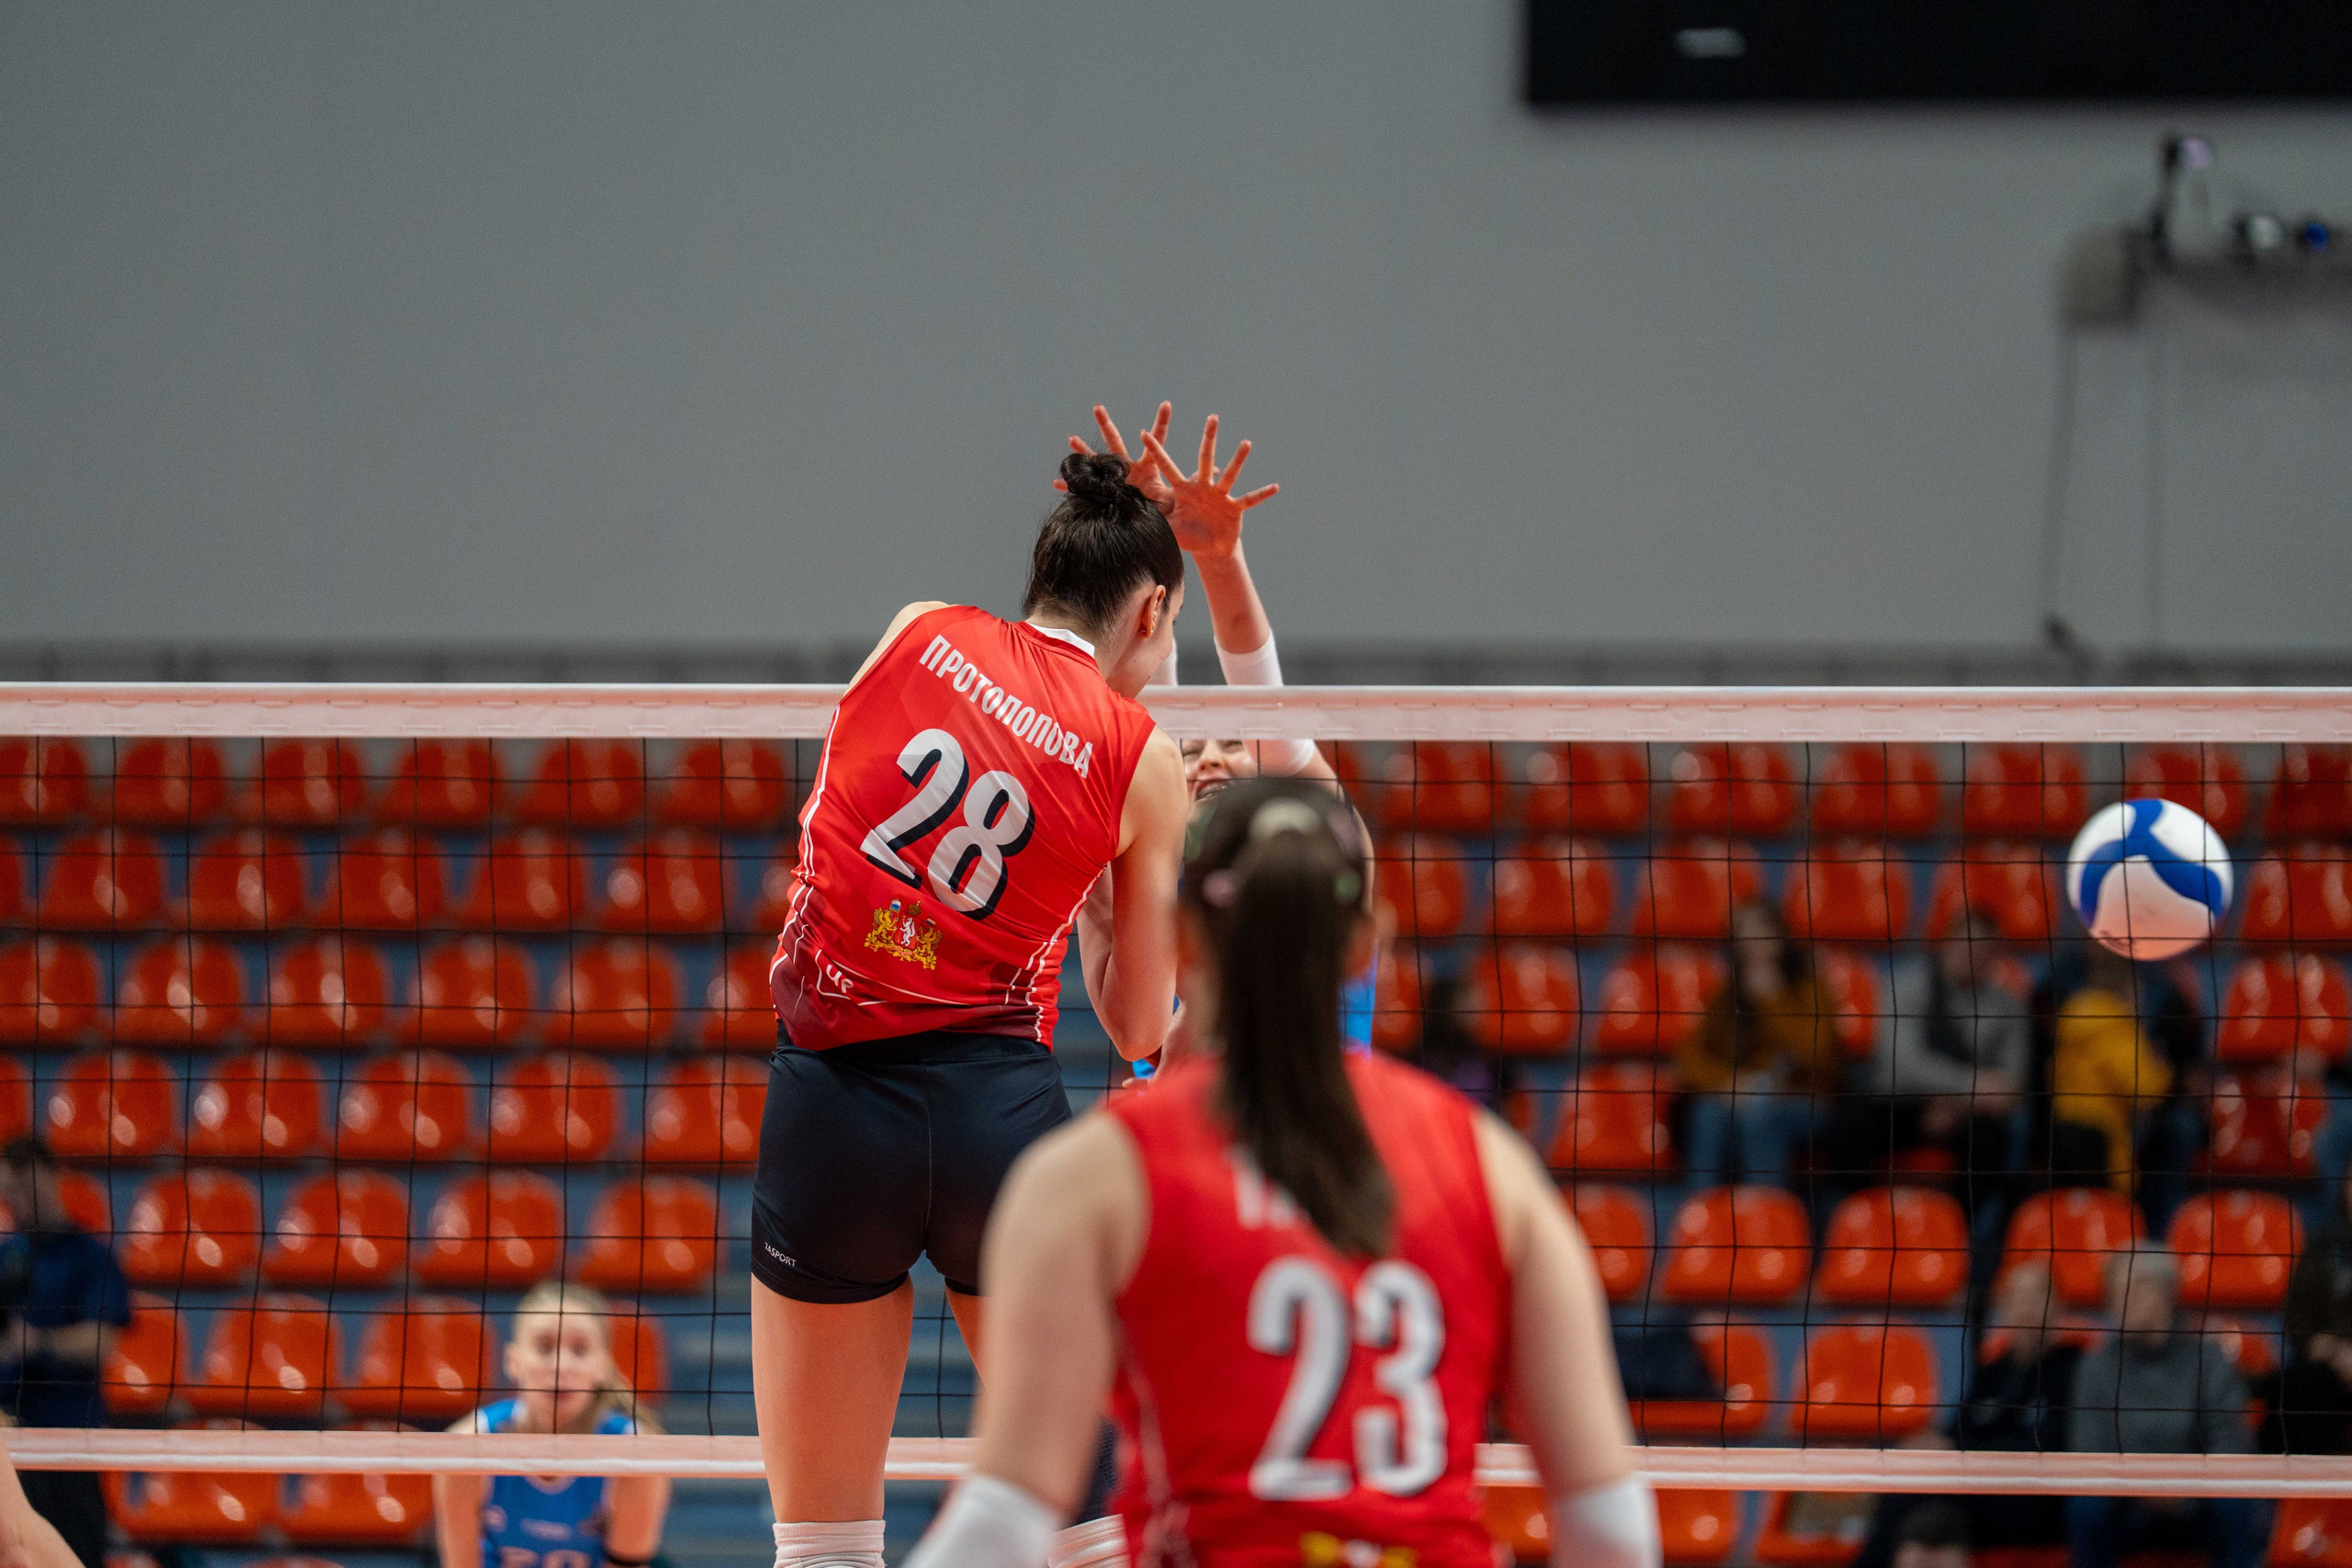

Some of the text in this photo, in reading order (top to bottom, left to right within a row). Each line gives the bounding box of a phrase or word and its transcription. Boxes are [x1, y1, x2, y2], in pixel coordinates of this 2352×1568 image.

[919, 635, 1093, 779] ПРОТОПОПОВА
[860, 728, 1035, 919] 28
[764, 1241, 797, 1267] ZASPORT
[1247, 1256, 1448, 1501] 23
